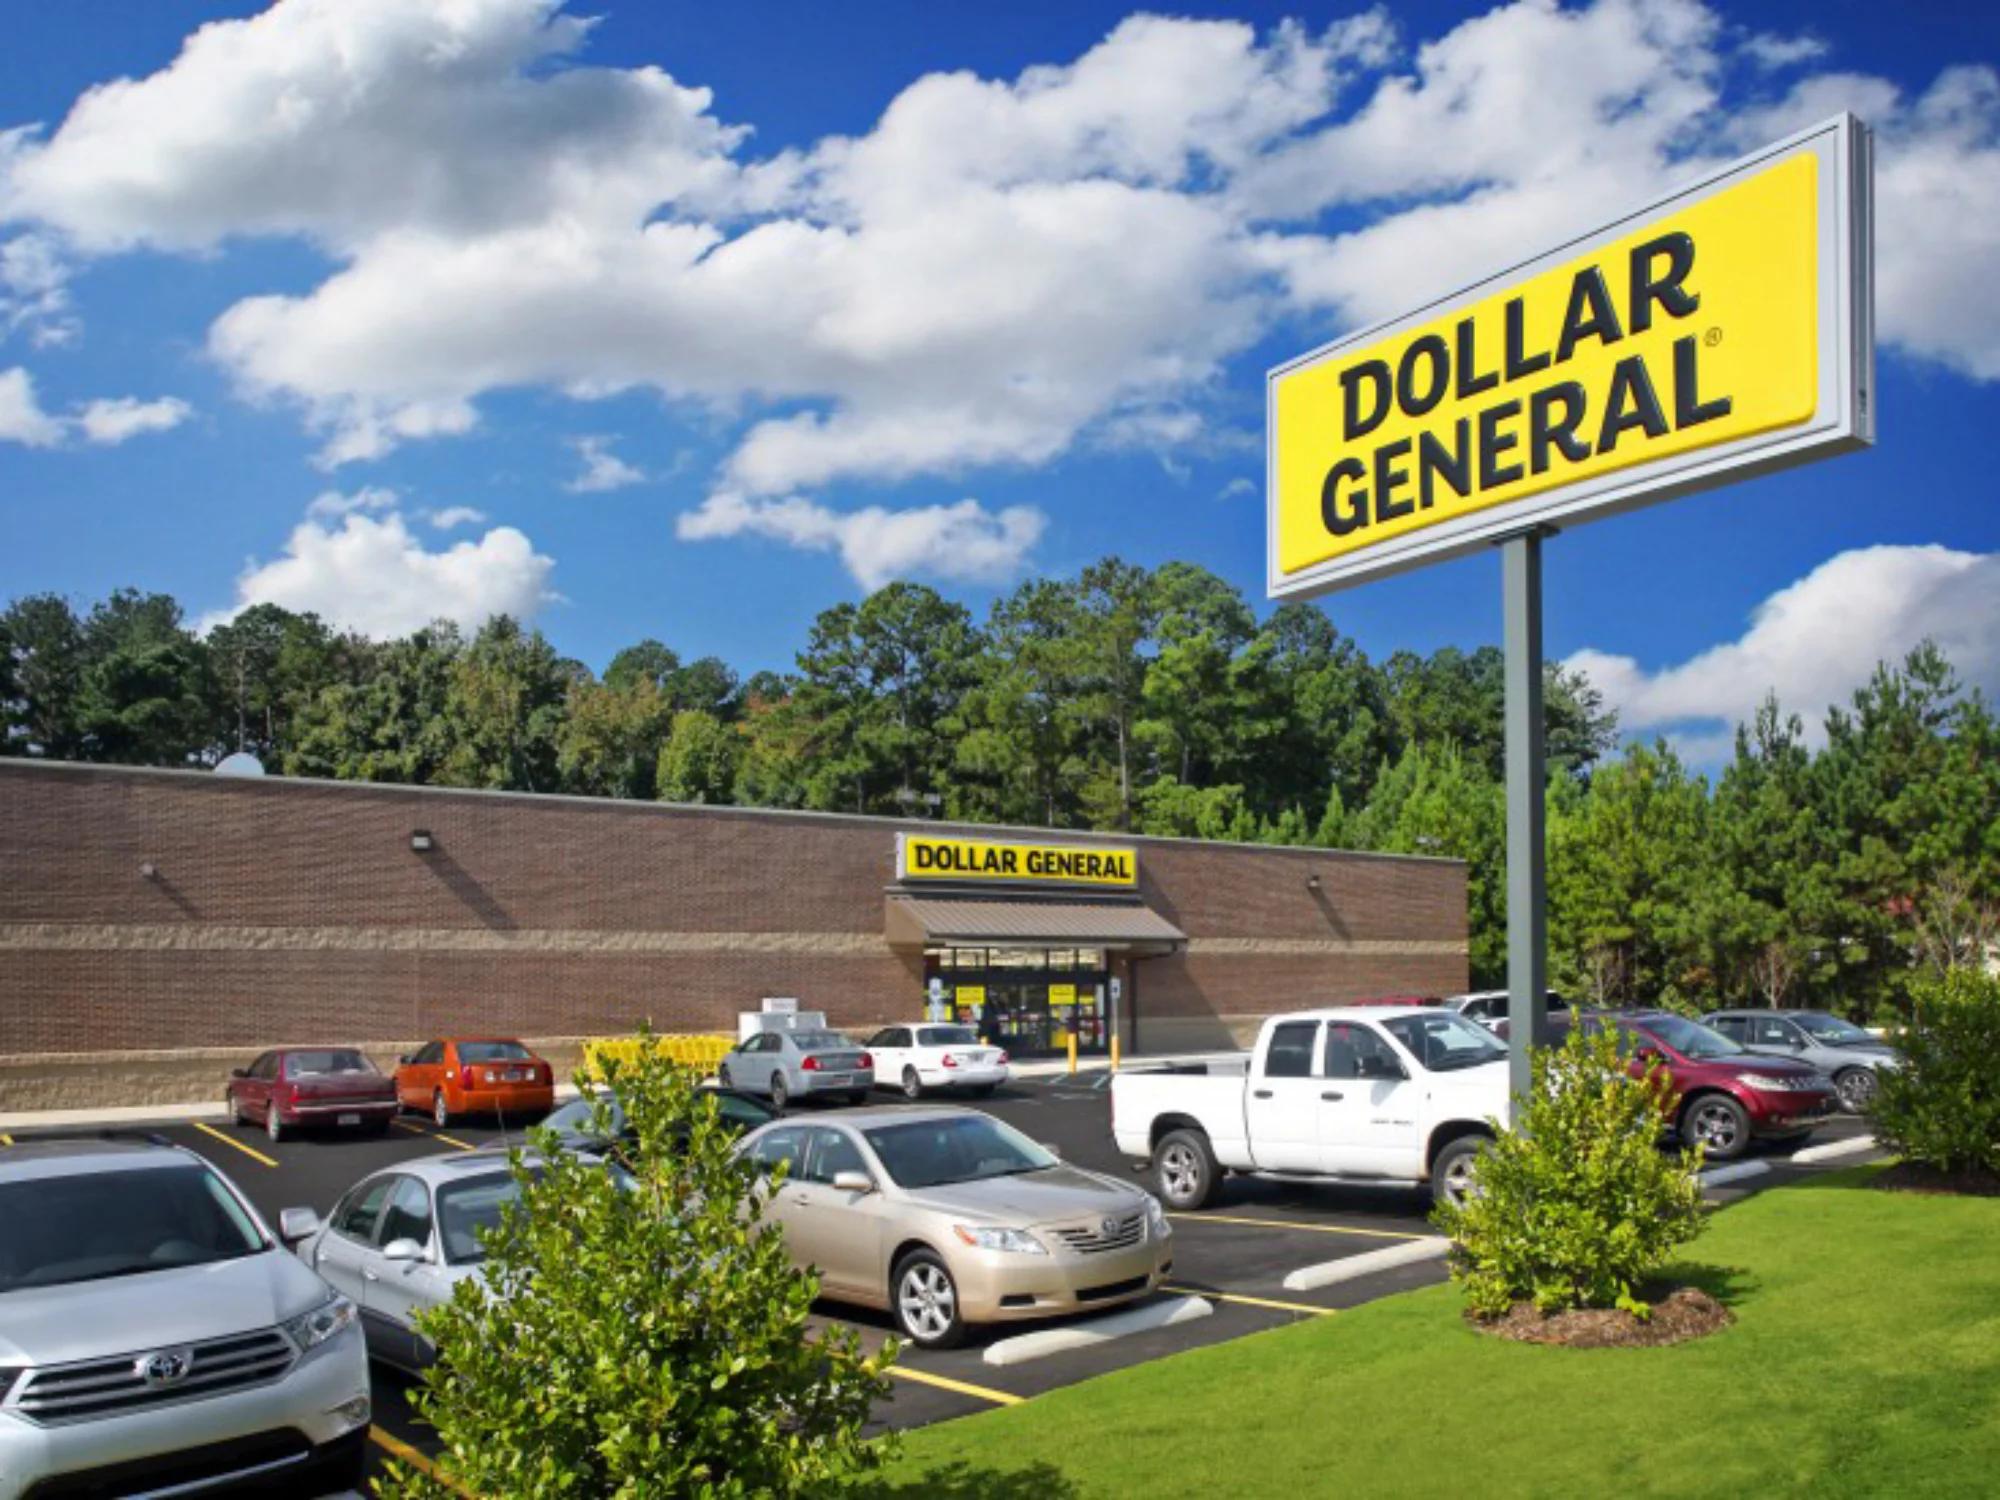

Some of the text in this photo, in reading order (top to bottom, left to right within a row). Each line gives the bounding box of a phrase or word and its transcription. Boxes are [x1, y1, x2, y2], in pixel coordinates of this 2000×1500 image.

[1320, 334, 1732, 537] GENERAL
[1339, 231, 1700, 442] DOLLAR
[914, 844, 1131, 879] DOLLAR GENERAL
